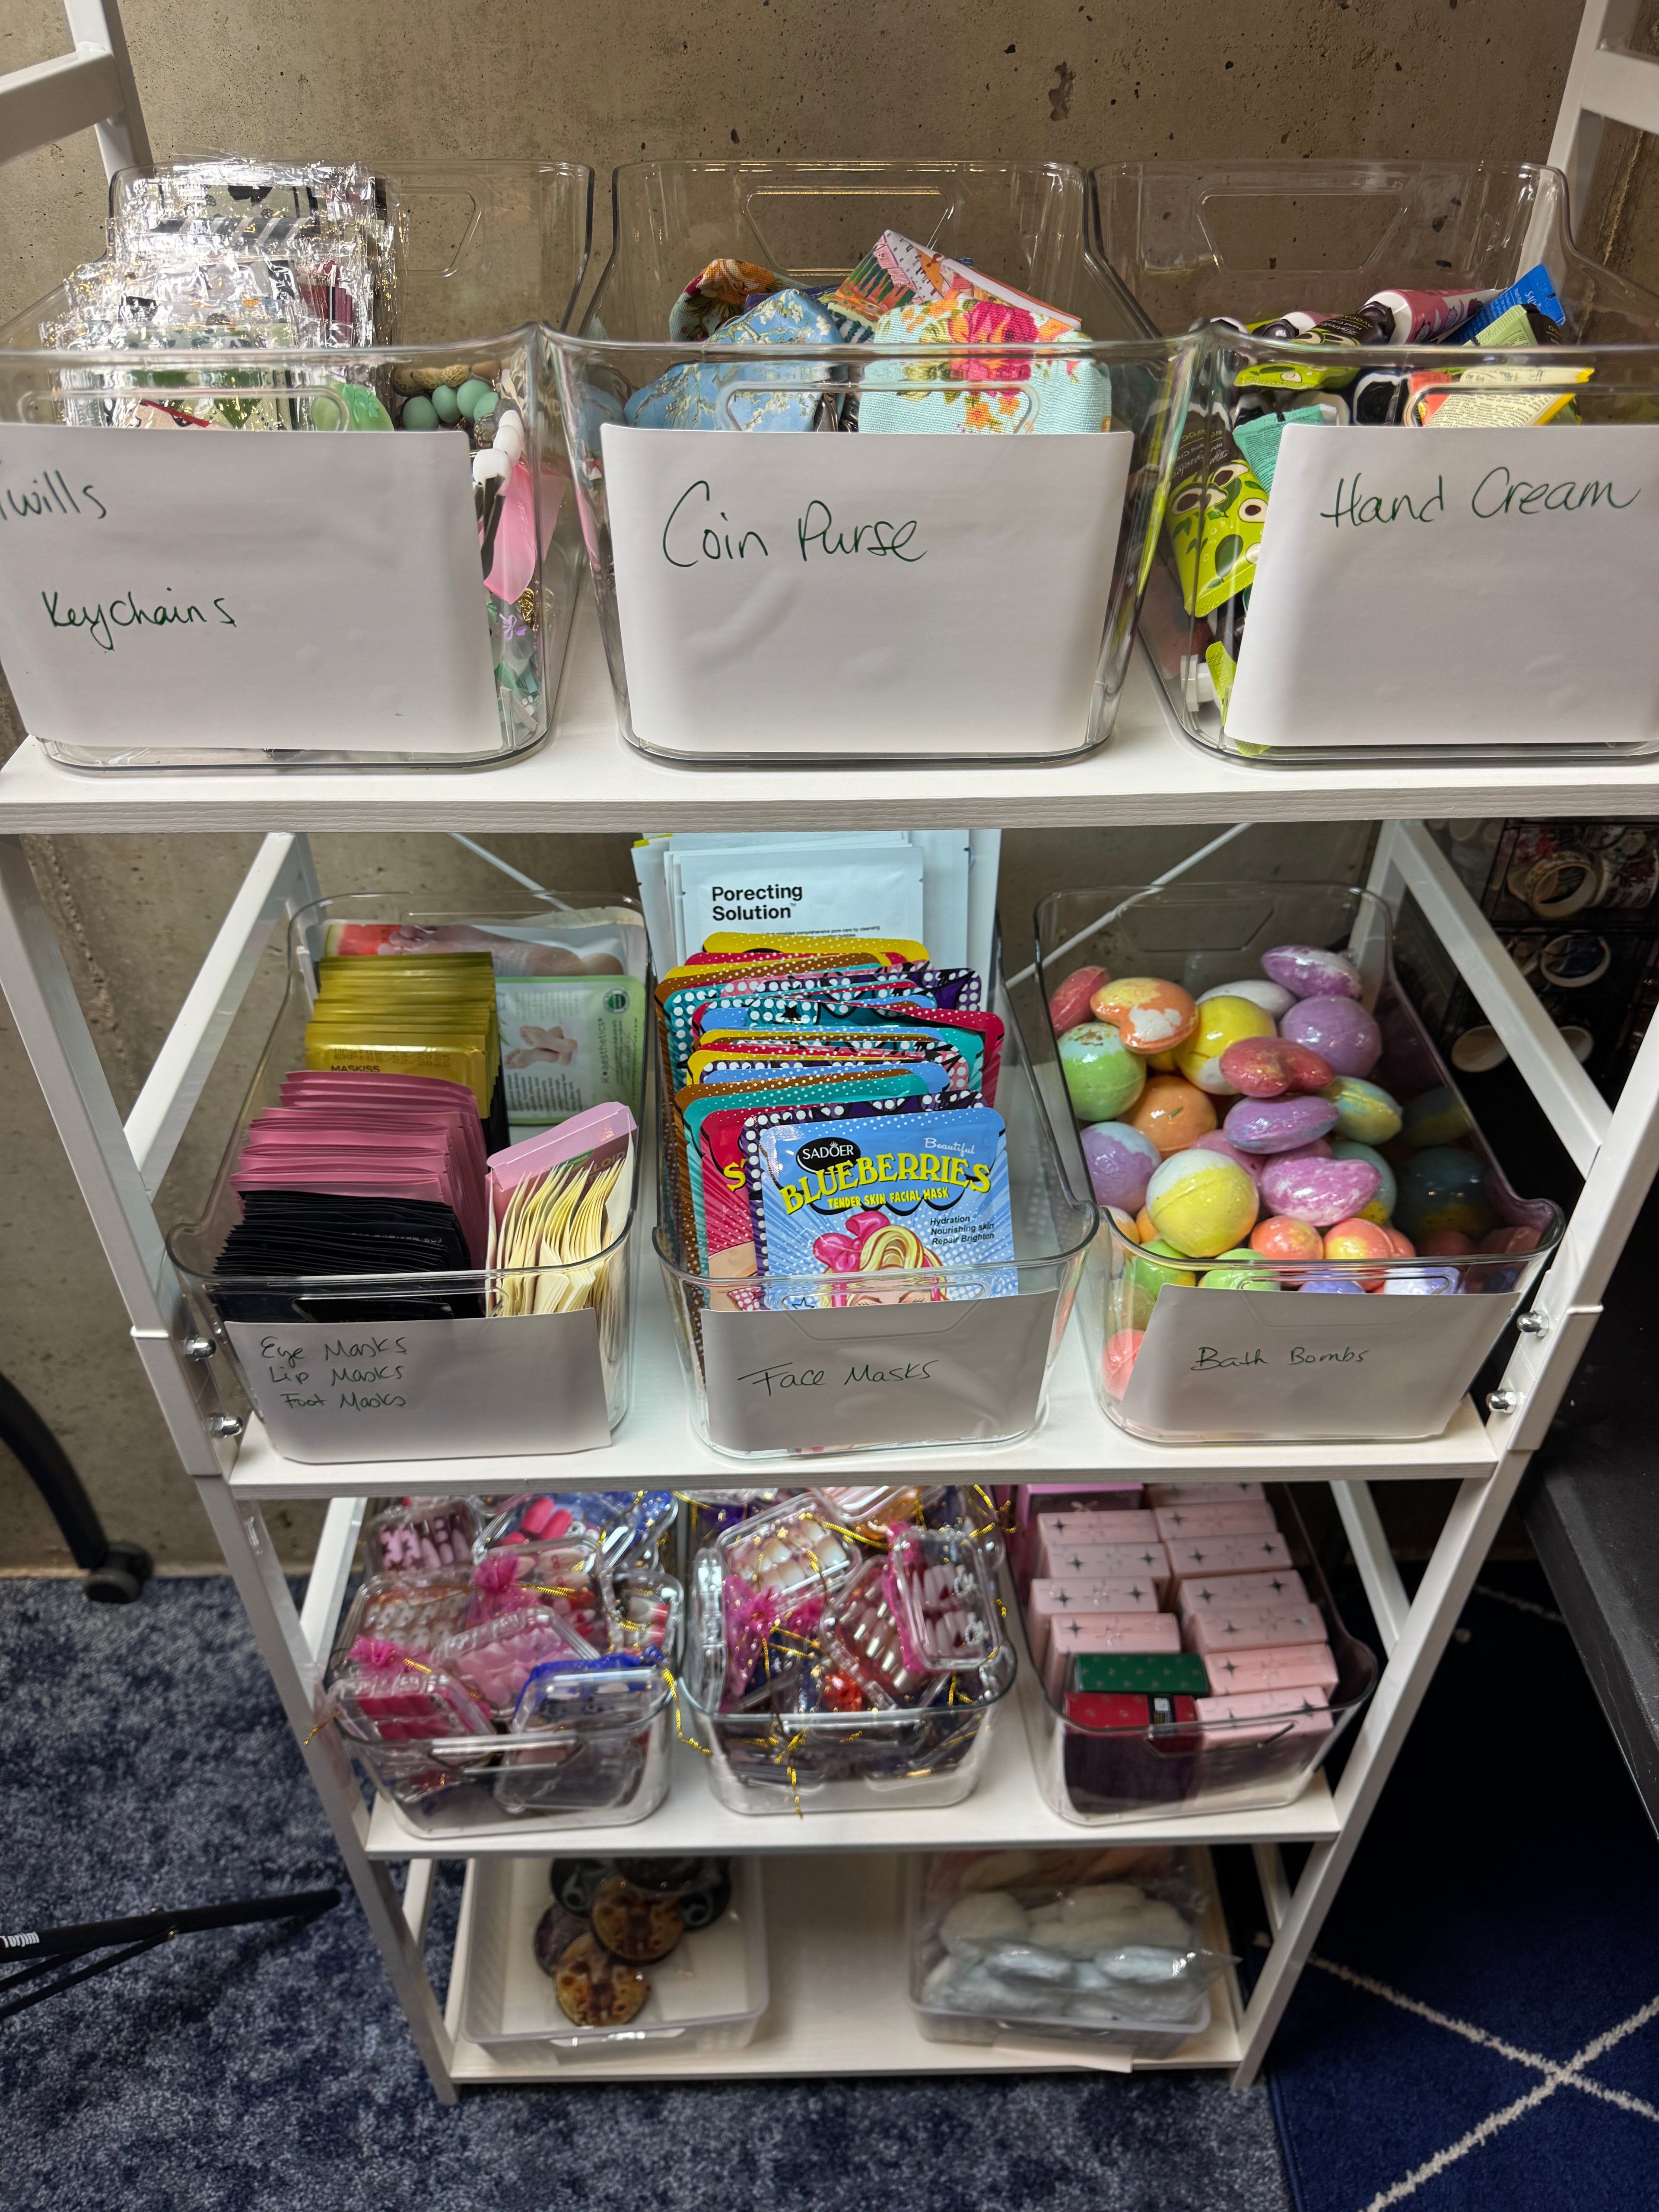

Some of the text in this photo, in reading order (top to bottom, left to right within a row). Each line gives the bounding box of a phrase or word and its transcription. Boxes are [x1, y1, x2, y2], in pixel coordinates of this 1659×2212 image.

[1320, 466, 1641, 528] Hand Cream
[663, 480, 928, 568] Coin Purse
[712, 884, 803, 902] Porecting
[712, 904, 791, 922] Solution
[802, 1143, 854, 1160] SADOER
[923, 1137, 975, 1157] Beautiful
[779, 1153, 991, 1214] BLUEBERRIES
[828, 1186, 949, 1209] TENDER SKIN FACIAL MASK
[930, 1215, 970, 1227] Hydration
[931, 1222, 995, 1236] Nourishing skin
[931, 1233, 995, 1246] Repair Brighten
[261, 1336, 407, 1368] Eye Masks
[1191, 1346, 1370, 1371] Bath Bombs
[269, 1365, 404, 1386] Lip Masks
[737, 1360, 939, 1396] Face Masks
[280, 1392, 406, 1412] Foot Masks
